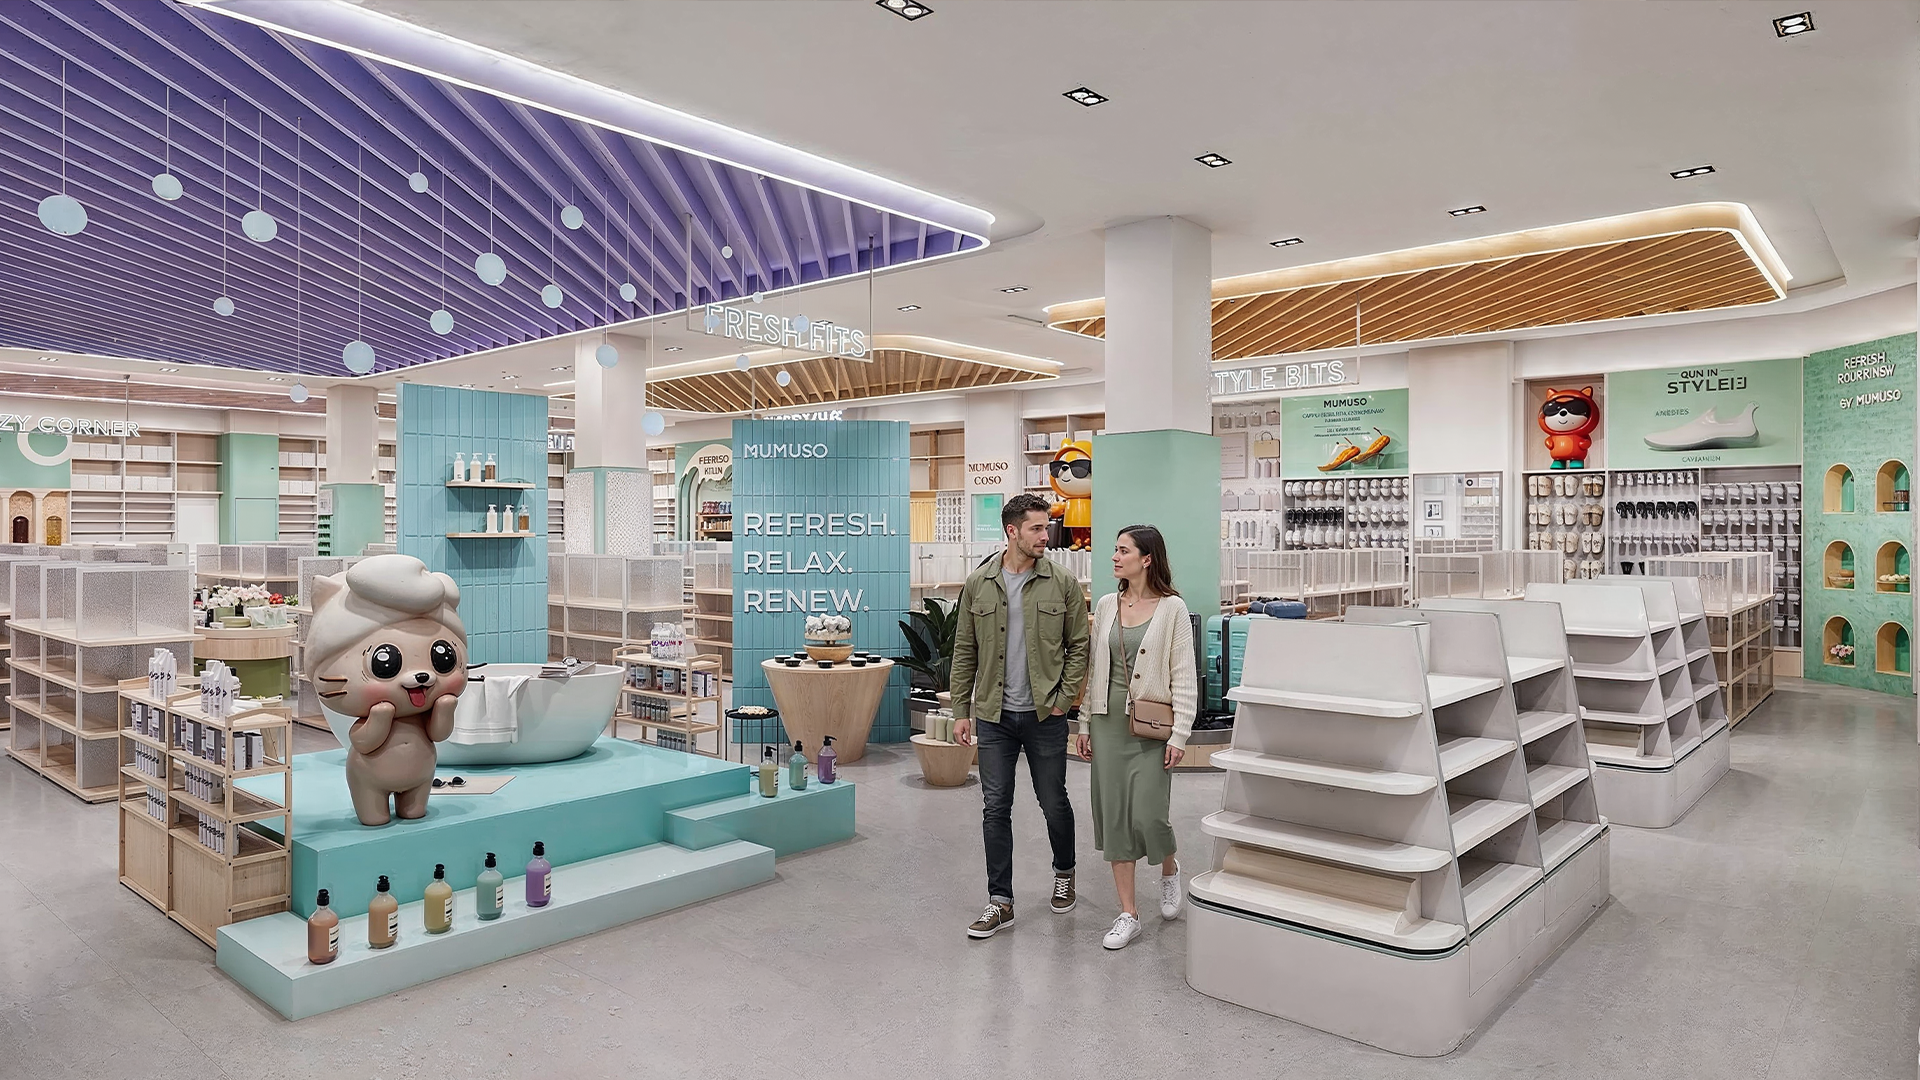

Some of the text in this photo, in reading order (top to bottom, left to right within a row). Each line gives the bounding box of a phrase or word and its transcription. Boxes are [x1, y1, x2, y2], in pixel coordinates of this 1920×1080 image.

[706, 303, 866, 357] FRESH FITS
[1214, 360, 1346, 395] TYLE BITS
[1680, 368, 1718, 379] QUN IN
[1323, 397, 1368, 409] MUMUSO
[1856, 388, 1902, 407] MUMUSO
[0, 413, 141, 438] ZY CORNER
[743, 442, 829, 459] MUMUSO
[968, 461, 1009, 472] MUMUSO
[973, 475, 1002, 485] COSO
[743, 512, 896, 537] REFRESH.
[743, 550, 854, 574] RELAX.
[743, 588, 870, 613] RENEW.
